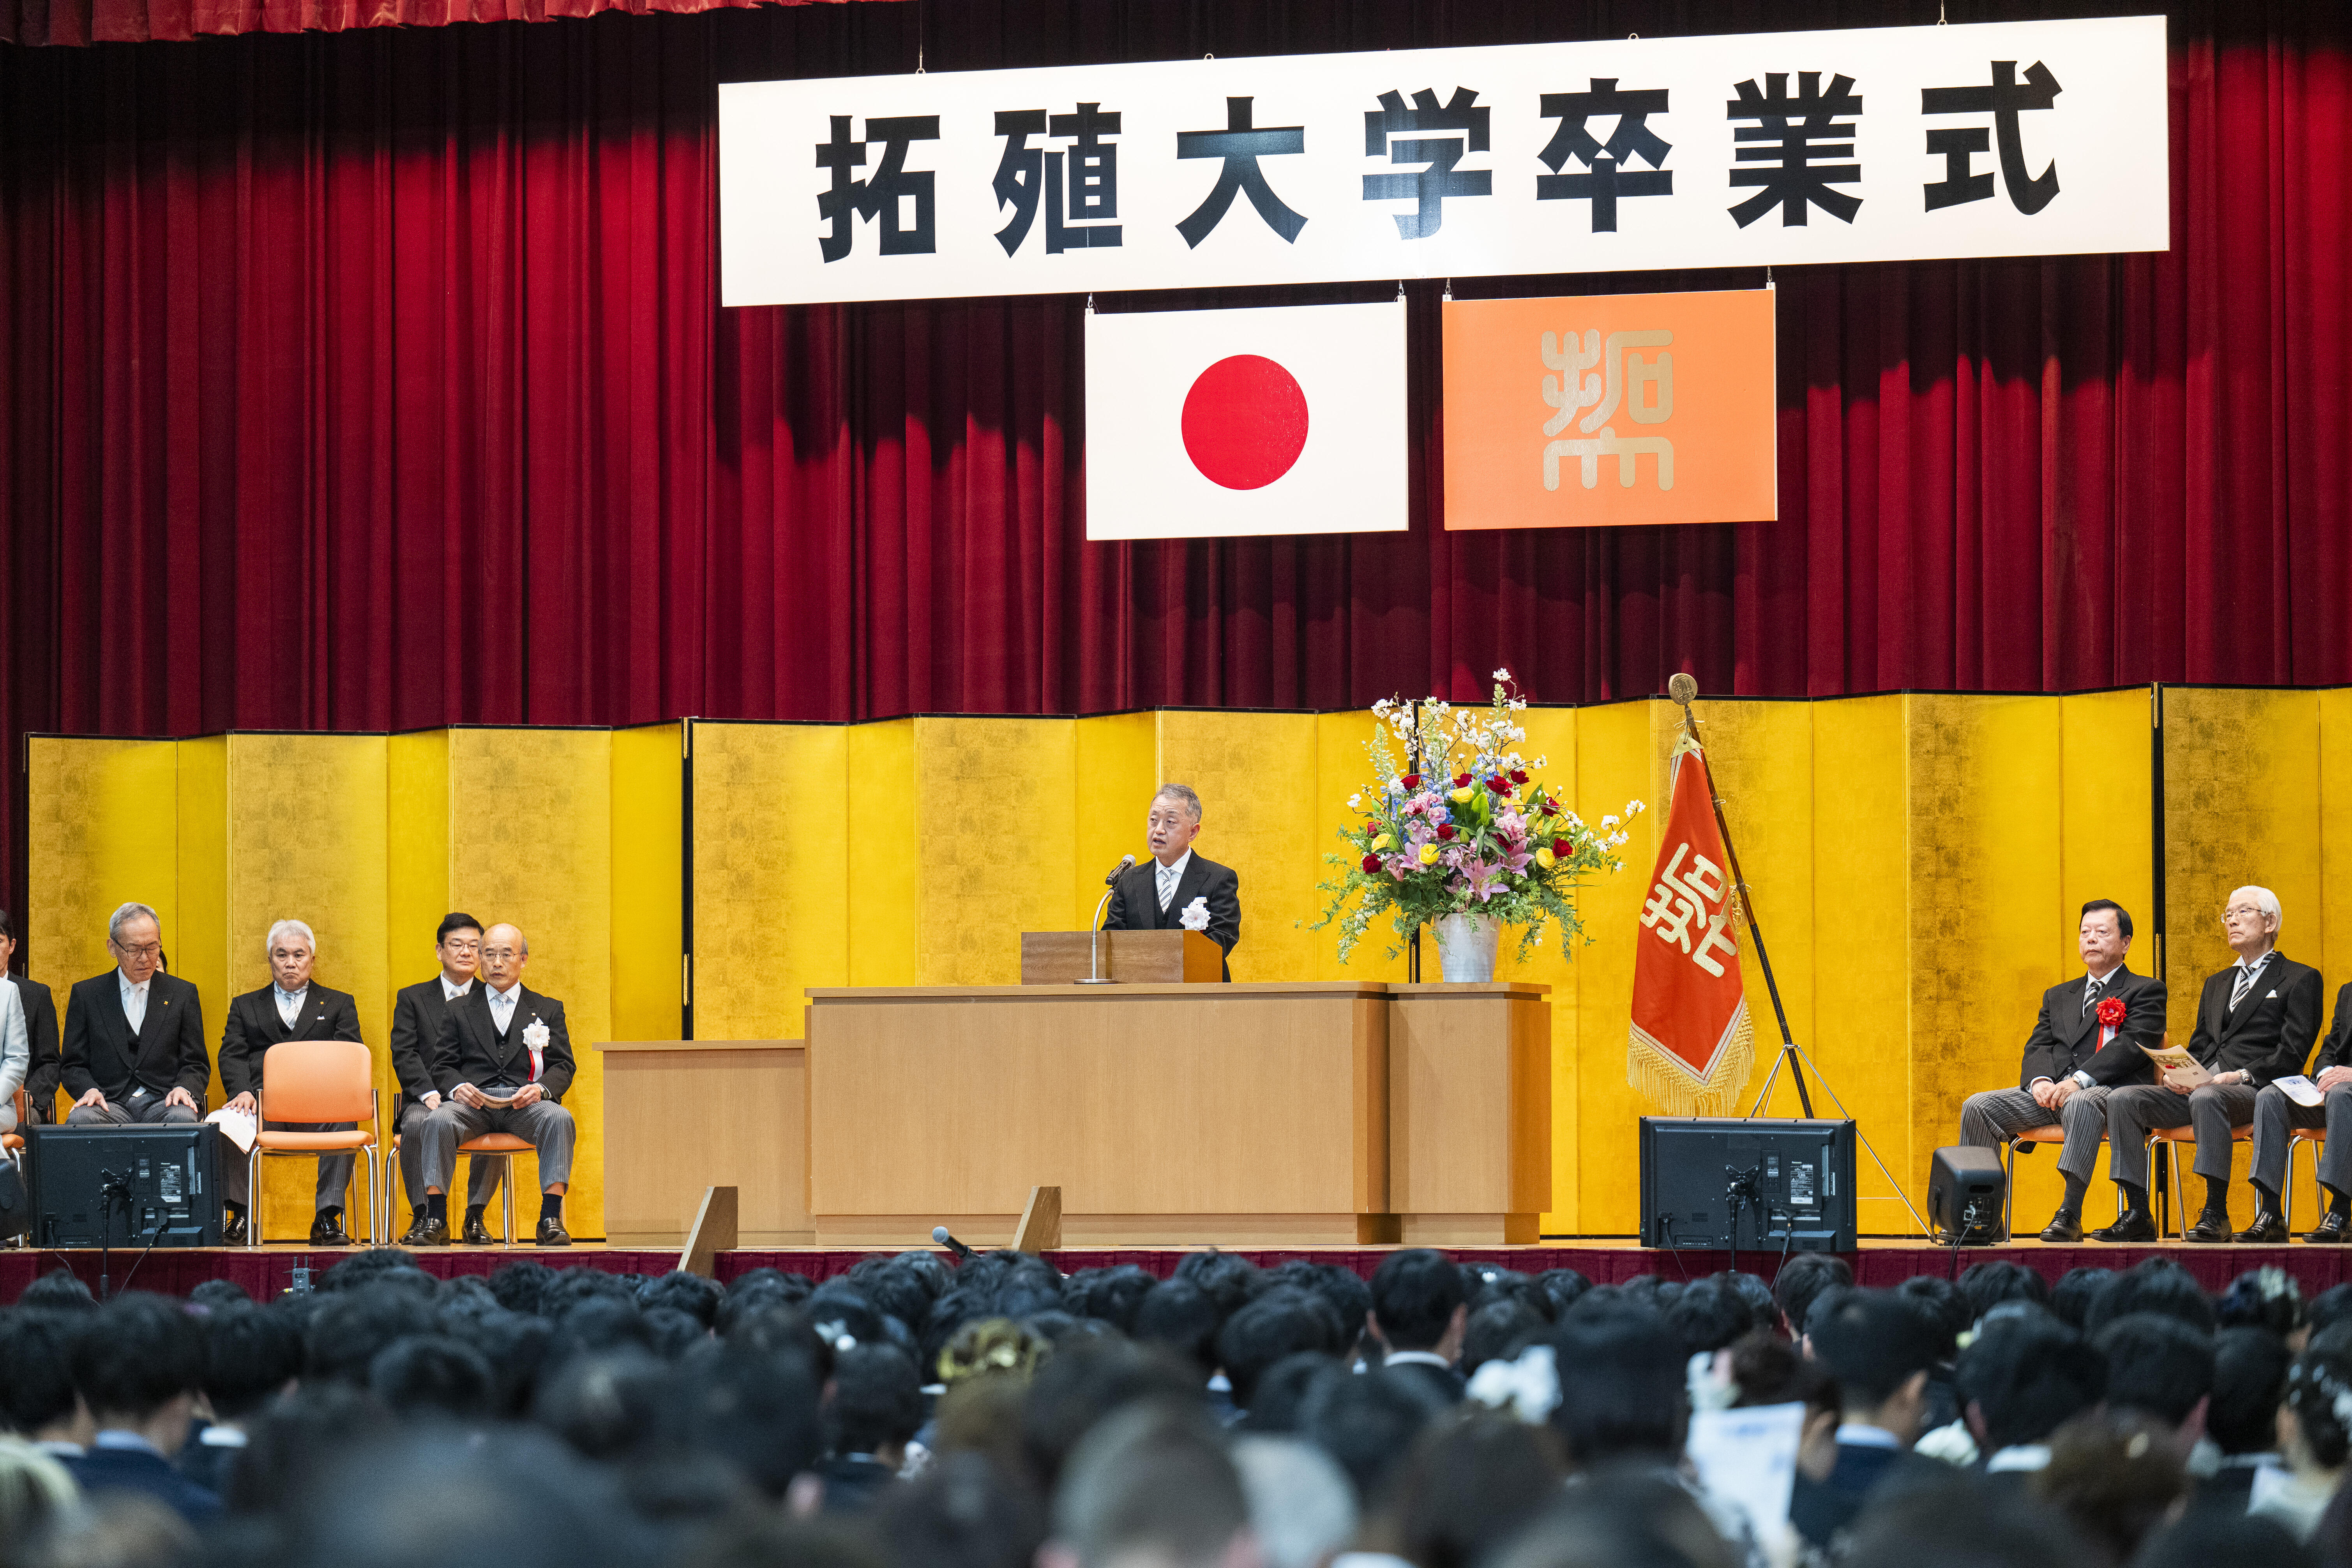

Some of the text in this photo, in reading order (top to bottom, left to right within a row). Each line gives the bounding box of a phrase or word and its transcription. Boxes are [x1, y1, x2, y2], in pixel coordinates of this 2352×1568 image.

[816, 60, 2062, 263] 拓殖大学卒業式
